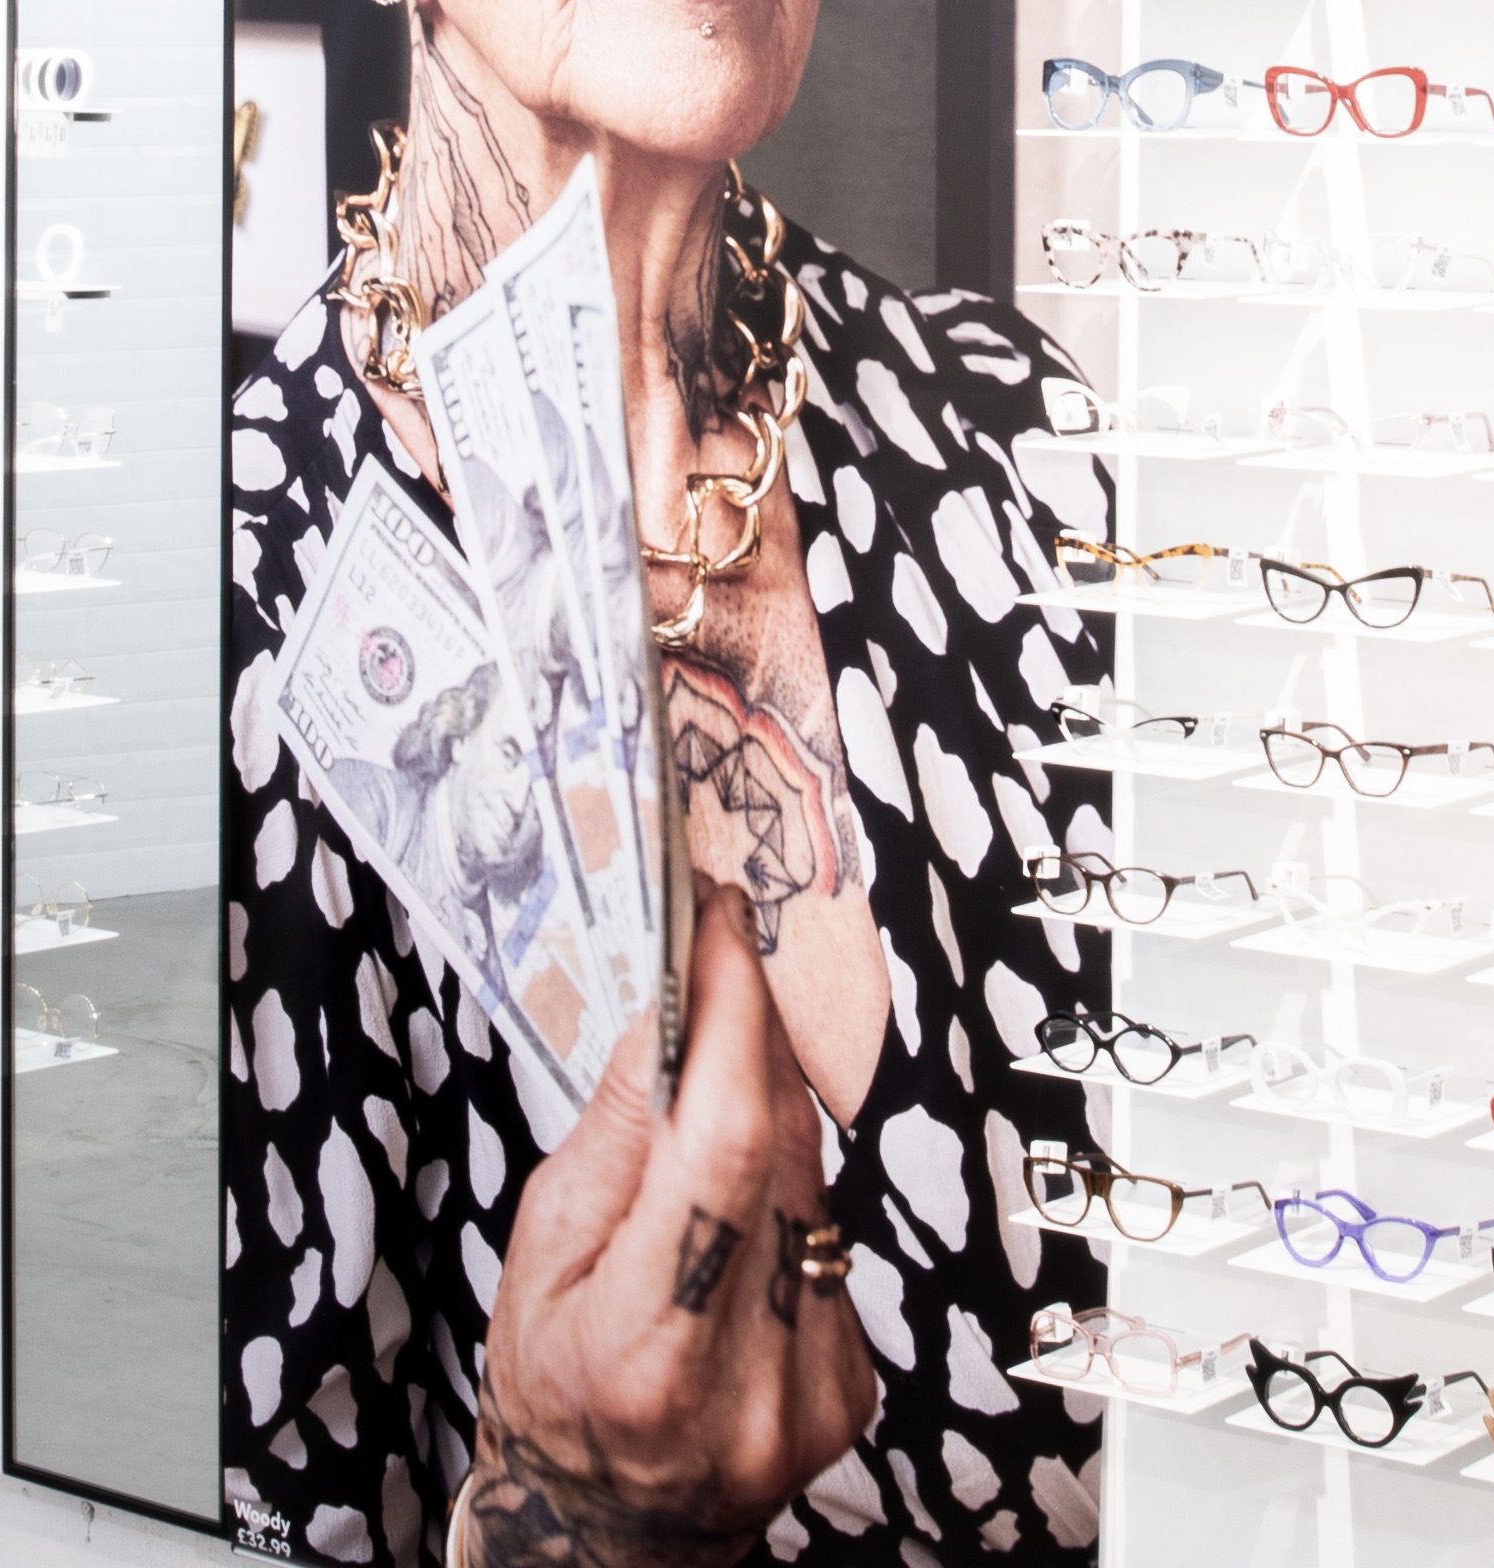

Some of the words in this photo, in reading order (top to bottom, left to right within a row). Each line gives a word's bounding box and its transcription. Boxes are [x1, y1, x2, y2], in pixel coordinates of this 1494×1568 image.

[371, 491, 436, 568] 100
[290, 696, 335, 772] 100
[233, 1498, 291, 1539] Woody
[237, 1527, 291, 1559] £32.99
